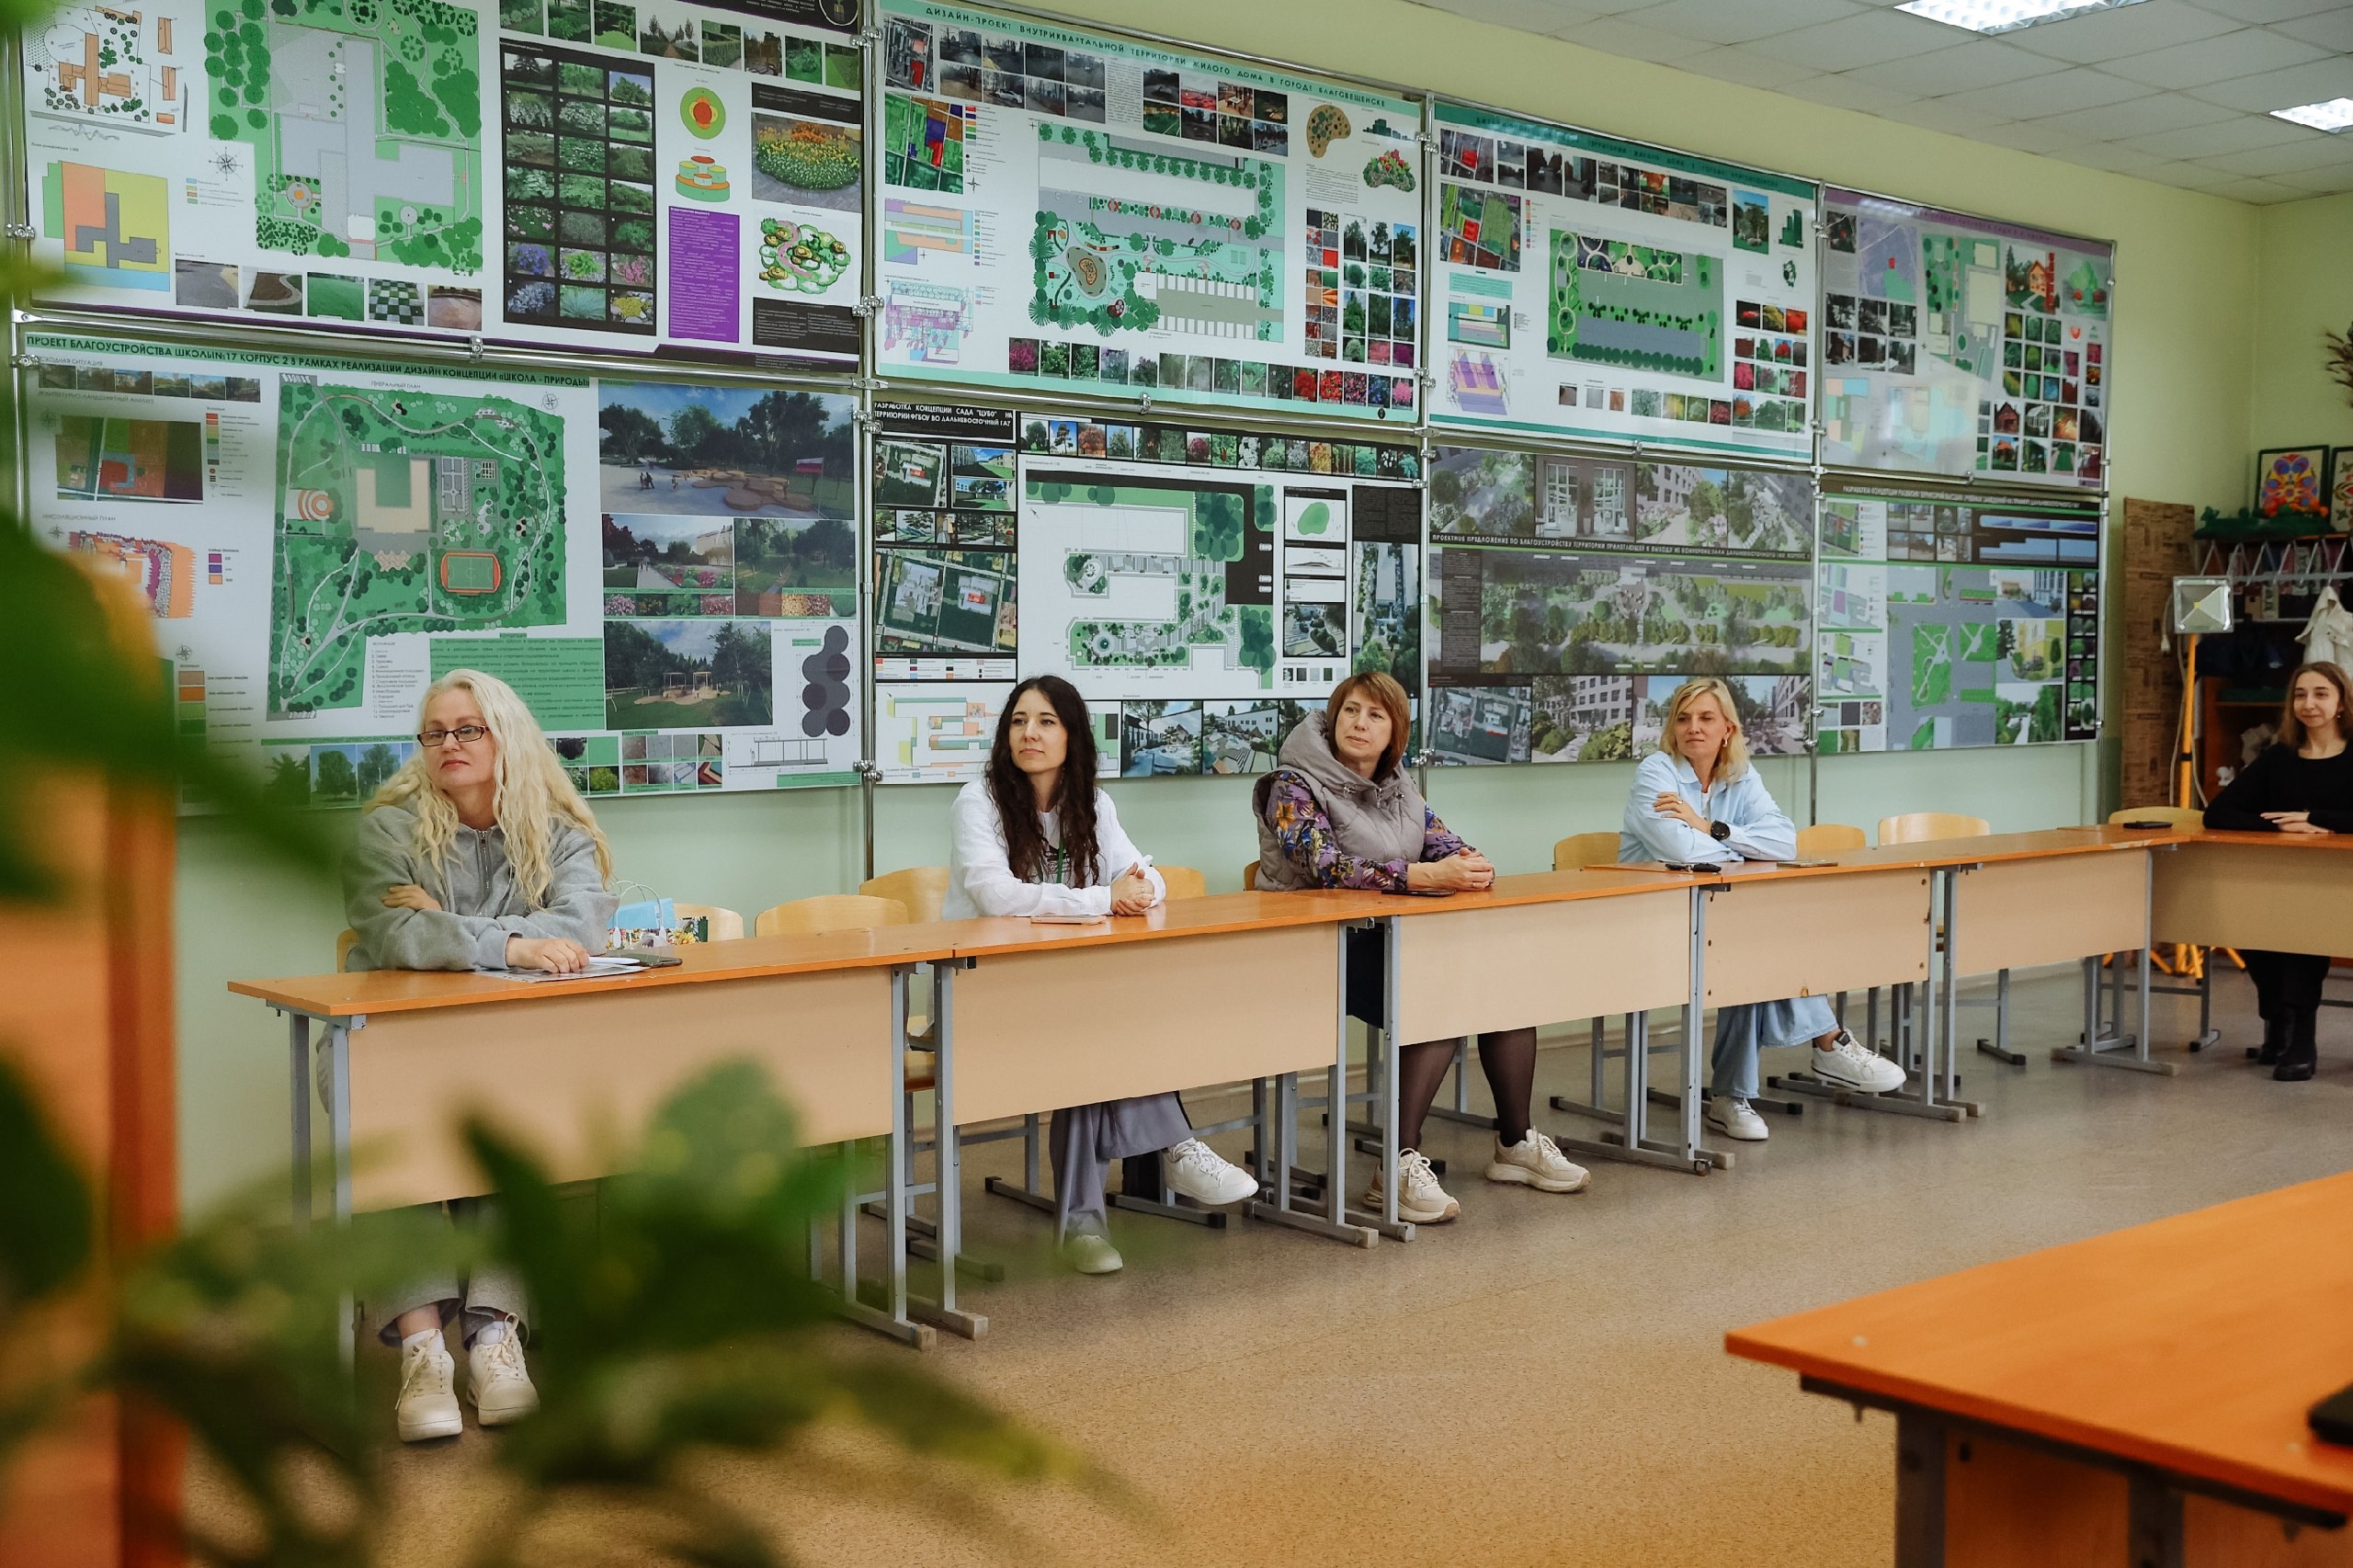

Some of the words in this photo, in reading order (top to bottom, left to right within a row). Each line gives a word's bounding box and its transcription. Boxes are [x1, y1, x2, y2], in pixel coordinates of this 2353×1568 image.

[1192, 61, 1230, 75] ЖИЛОГО
[1237, 71, 1263, 82] ДОМА
[1319, 86, 1386, 108] БЛАГОВЕЩЕНСКЕ
[27, 336, 67, 348] ПРОЕКТ
[70, 338, 172, 357] БЛАГОУСТРОЙСТВА
[241, 354, 279, 365] КОРПУС
[282, 356, 288, 365] 2
[291, 357, 296, 366] В
[299, 358, 339, 369] РАМКАХ
[341, 360, 402, 374] РЕАЛИЗАЦИИ
[404, 366, 441, 377] ДИЗАЙН
[443, 369, 497, 381] КОНЦЕПЦИИ
[38, 356, 71, 364] СХОДНАЯ
[915, 404, 952, 414] КОНЦЕПЦИИ
[956, 407, 973, 415] САДА
[941, 415, 999, 426] ДАЛЬНЕВОСТОЧНЫЙ
[1433, 534, 1465, 542] ПРОЕКТНОЕ
[1467, 536, 1508, 544] ПРЕДЛОЖЕНИЕ
[1519, 538, 1572, 548] БЛАГОУСТРОЙСТВУ
